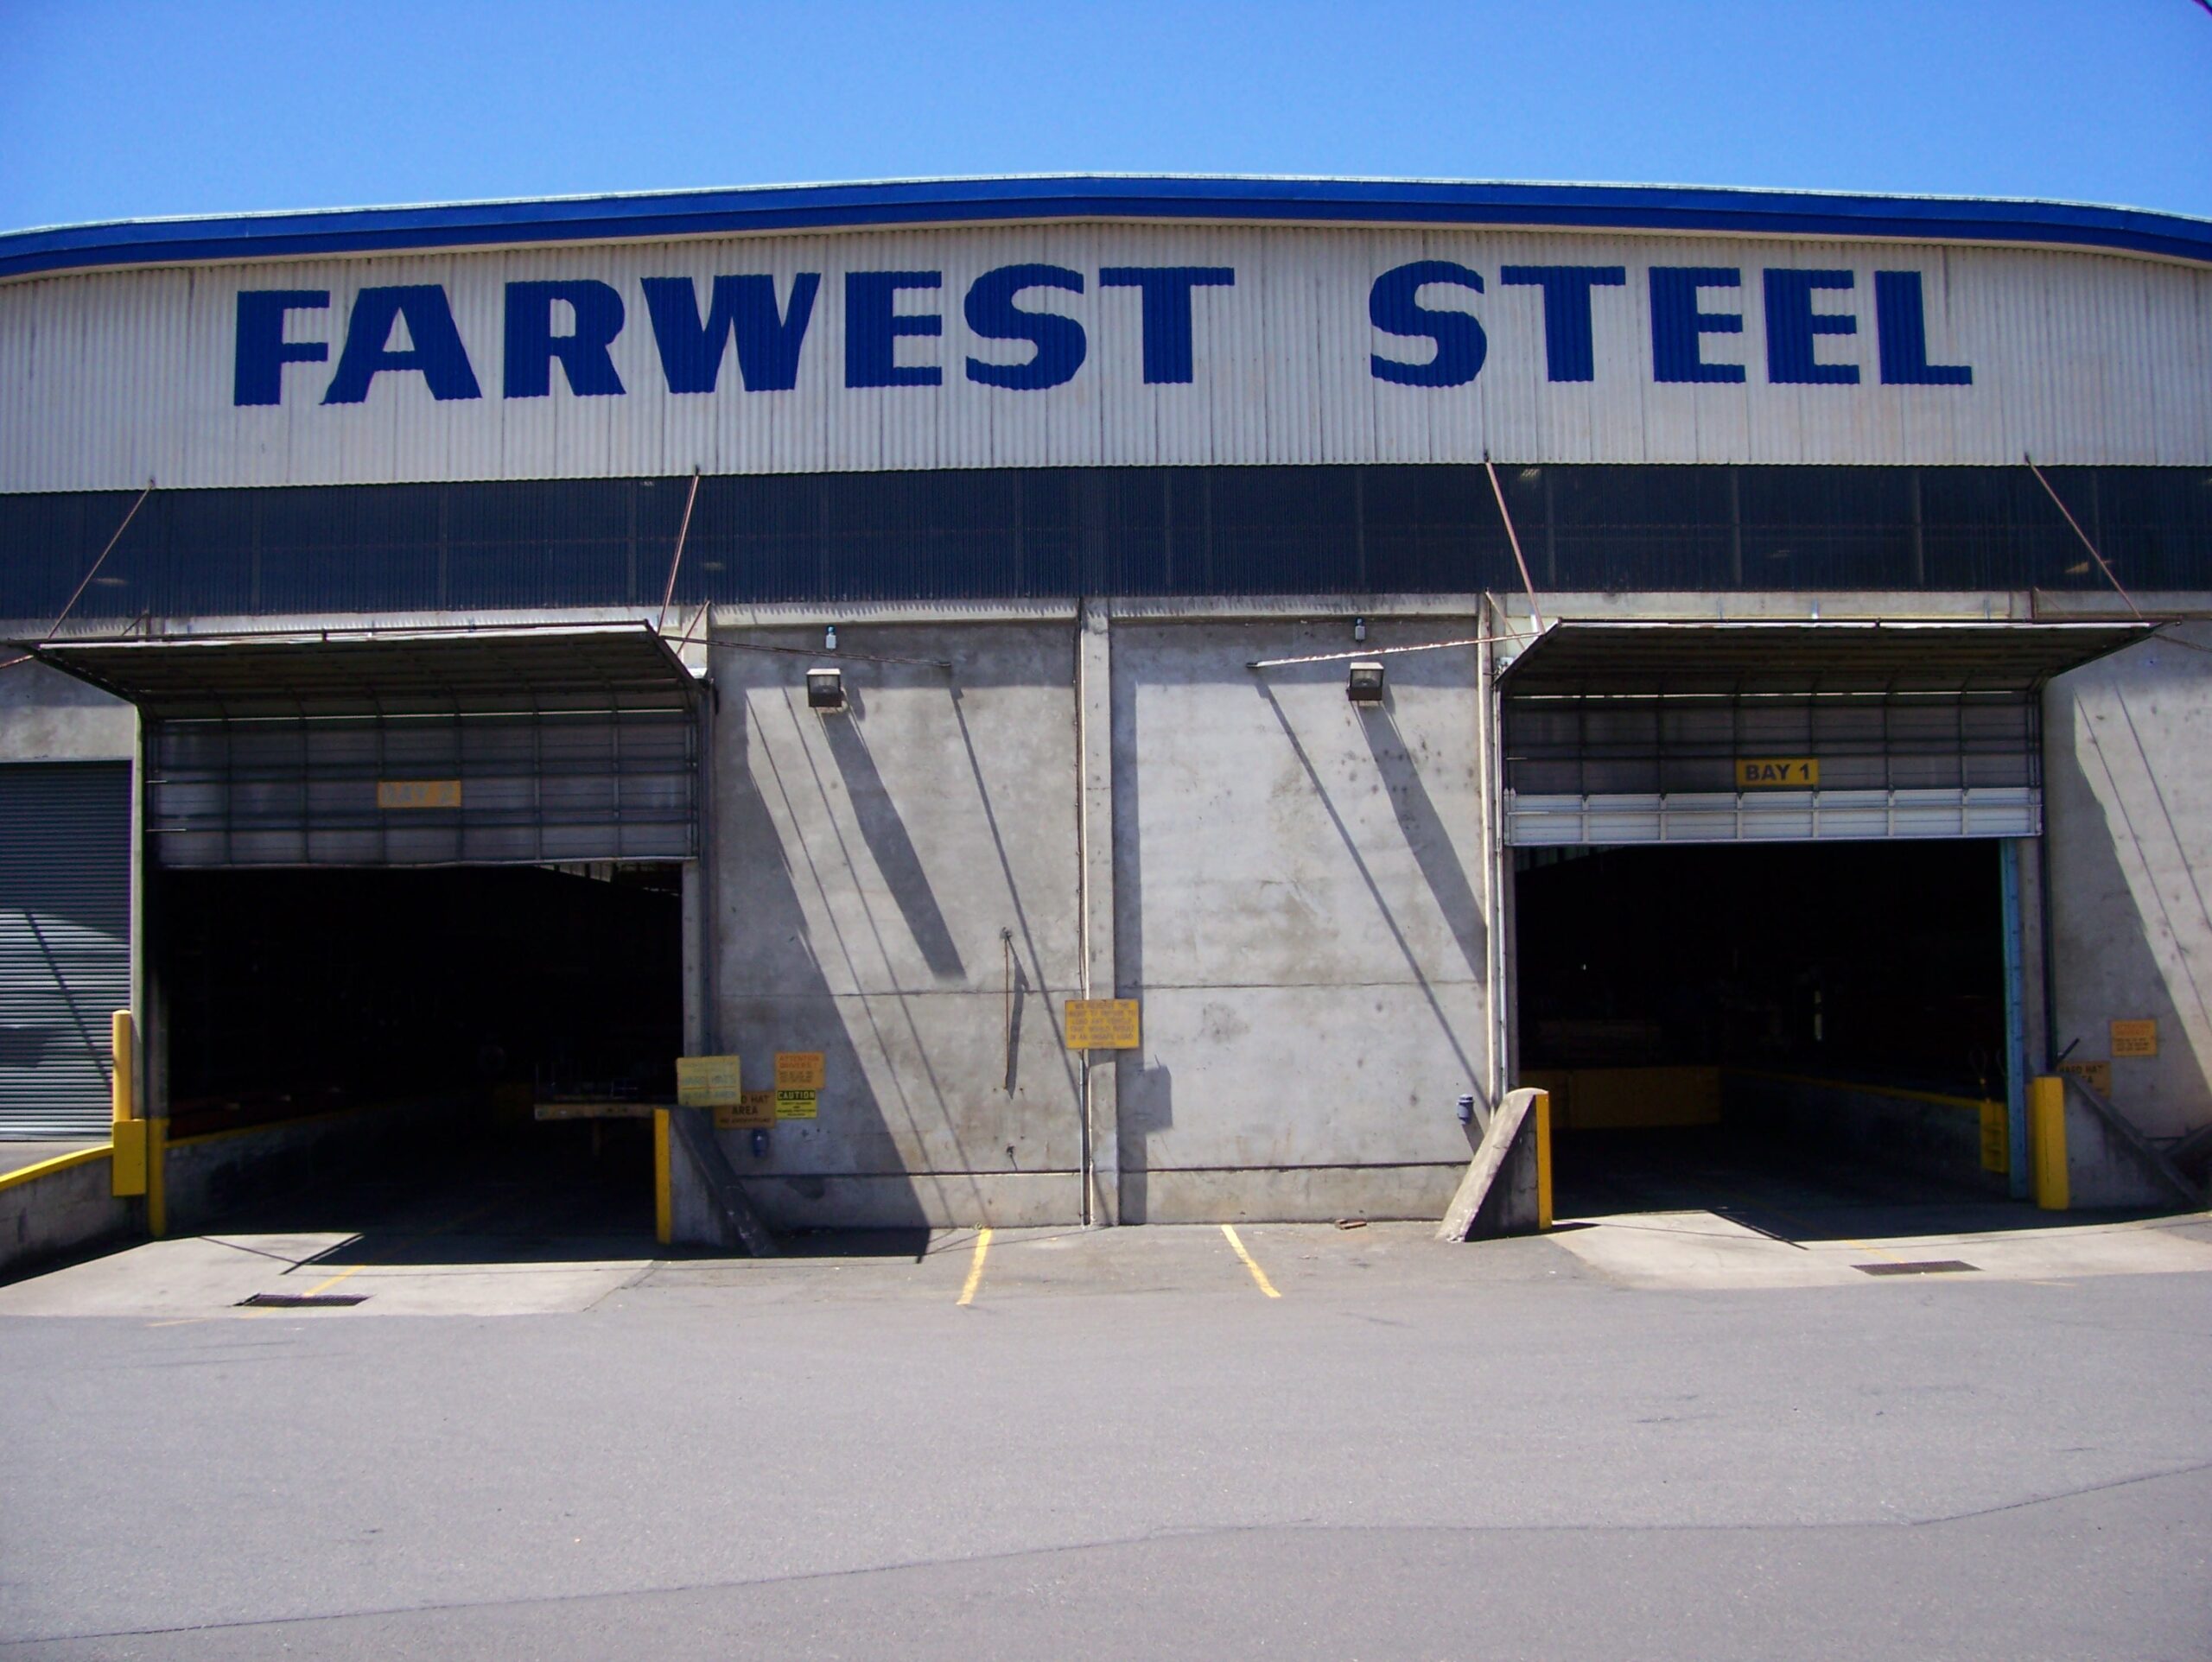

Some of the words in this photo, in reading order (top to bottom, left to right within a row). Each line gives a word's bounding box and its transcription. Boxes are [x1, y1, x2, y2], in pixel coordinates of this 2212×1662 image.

[235, 263, 1235, 406] FARWEST
[1369, 260, 1973, 388] STEEL
[1746, 764, 1791, 780] BAY
[1799, 763, 1809, 780] 1
[751, 1094, 770, 1104] HAT
[778, 1091, 815, 1100] CAUTION
[732, 1106, 758, 1114] AREA
